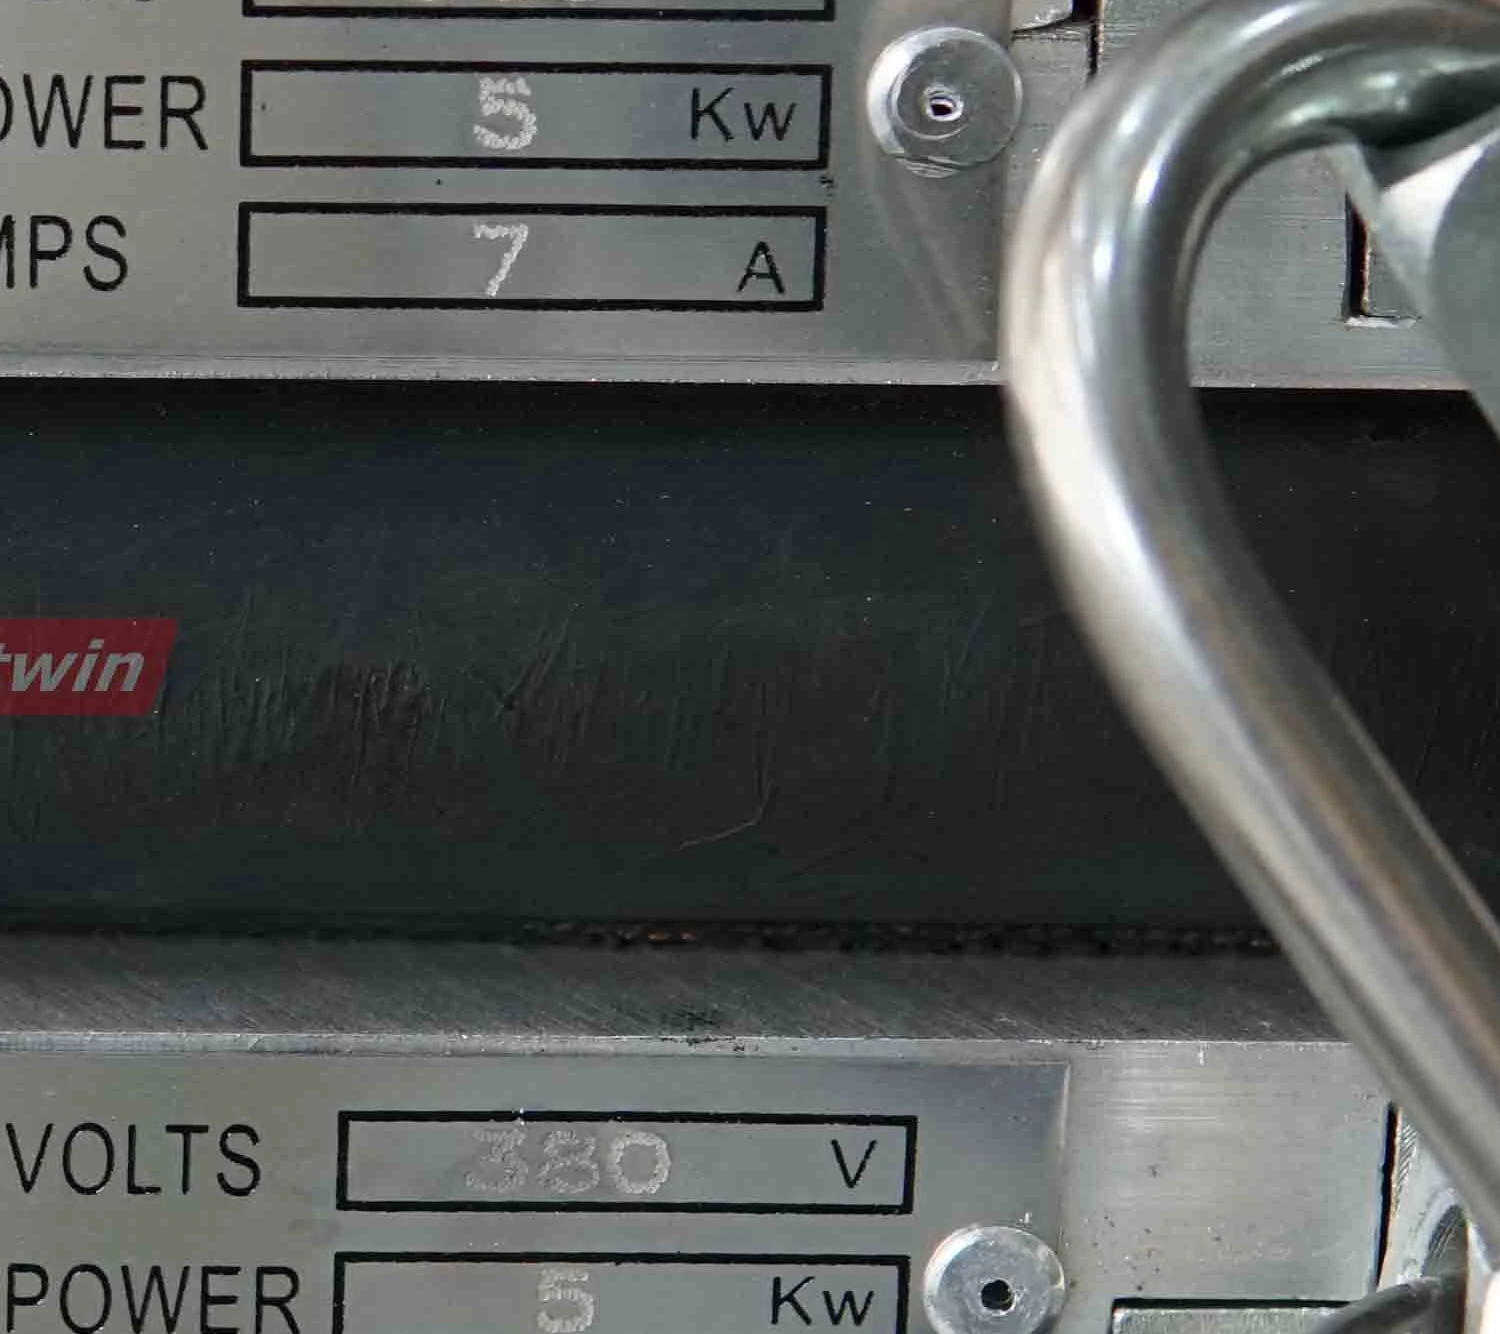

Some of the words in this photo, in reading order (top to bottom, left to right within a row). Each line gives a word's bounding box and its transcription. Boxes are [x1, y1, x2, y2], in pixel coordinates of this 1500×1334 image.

[472, 76, 539, 153] 5
[689, 85, 797, 144] Kw
[472, 222, 530, 298] 7
[736, 242, 787, 296] A
[5, 1121, 263, 1197] VOLTS
[461, 1129, 673, 1196] 380
[829, 1138, 879, 1191] V
[769, 1275, 878, 1329] Kw
